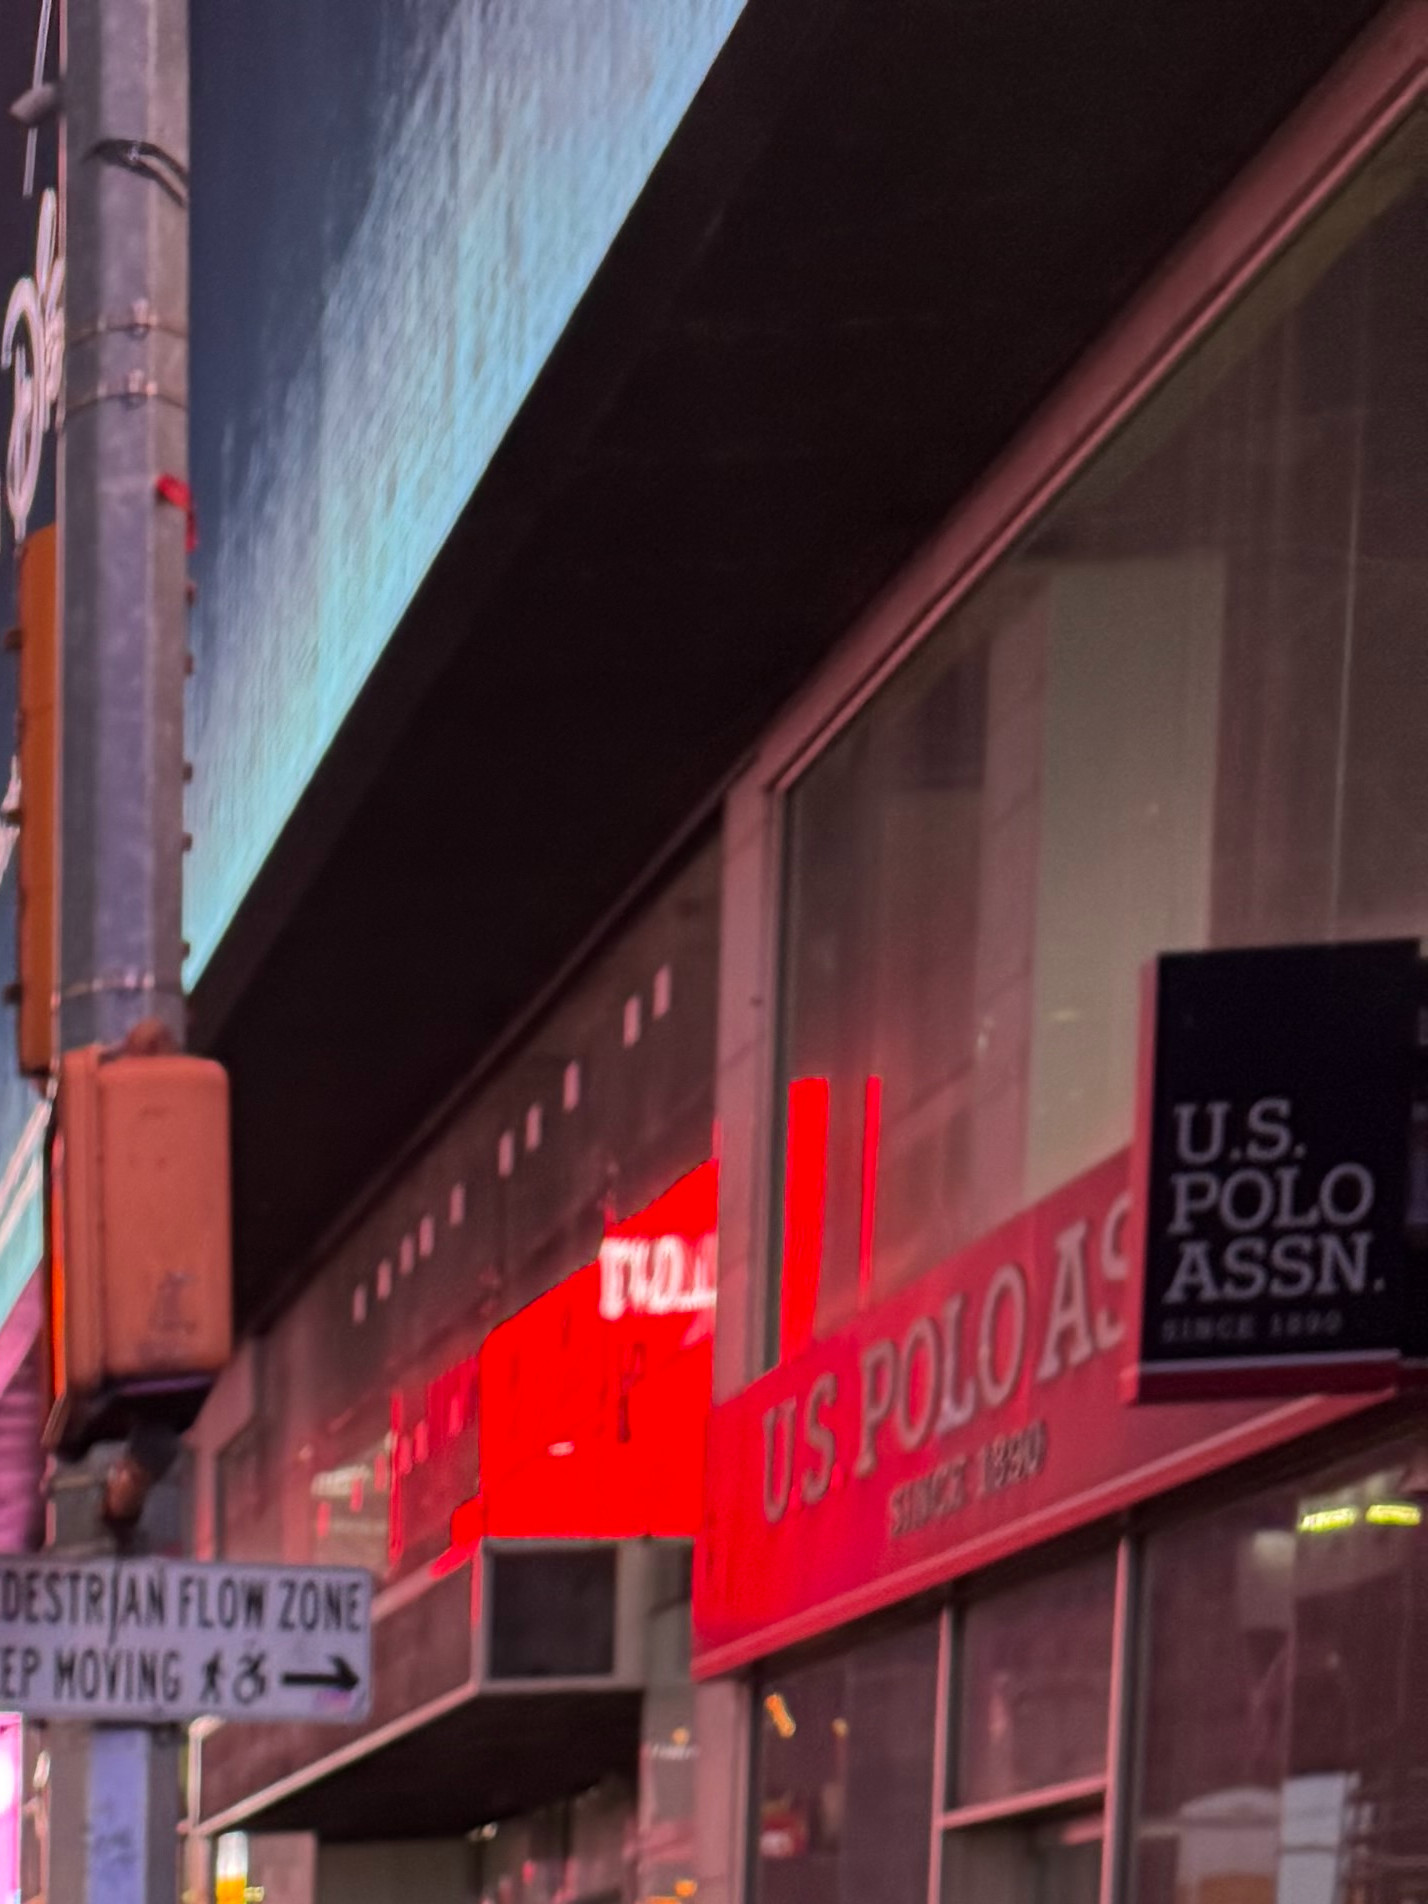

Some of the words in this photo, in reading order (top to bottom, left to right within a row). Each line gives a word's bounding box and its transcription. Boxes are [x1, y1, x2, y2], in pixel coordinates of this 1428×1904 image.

[1172, 1097, 1307, 1164] U.S.
[1167, 1161, 1376, 1236] POLO
[1162, 1231, 1387, 1305] ASSN.
[1161, 1314, 1254, 1343] SINCE
[1269, 1309, 1343, 1337] 1890
[855, 1262, 1028, 1480] POLO
[888, 1455, 968, 1538] SINCE
[177, 1576, 266, 1631] FLOW
[277, 1581, 364, 1634] ZONE
[52, 1647, 183, 1704] MOVING
